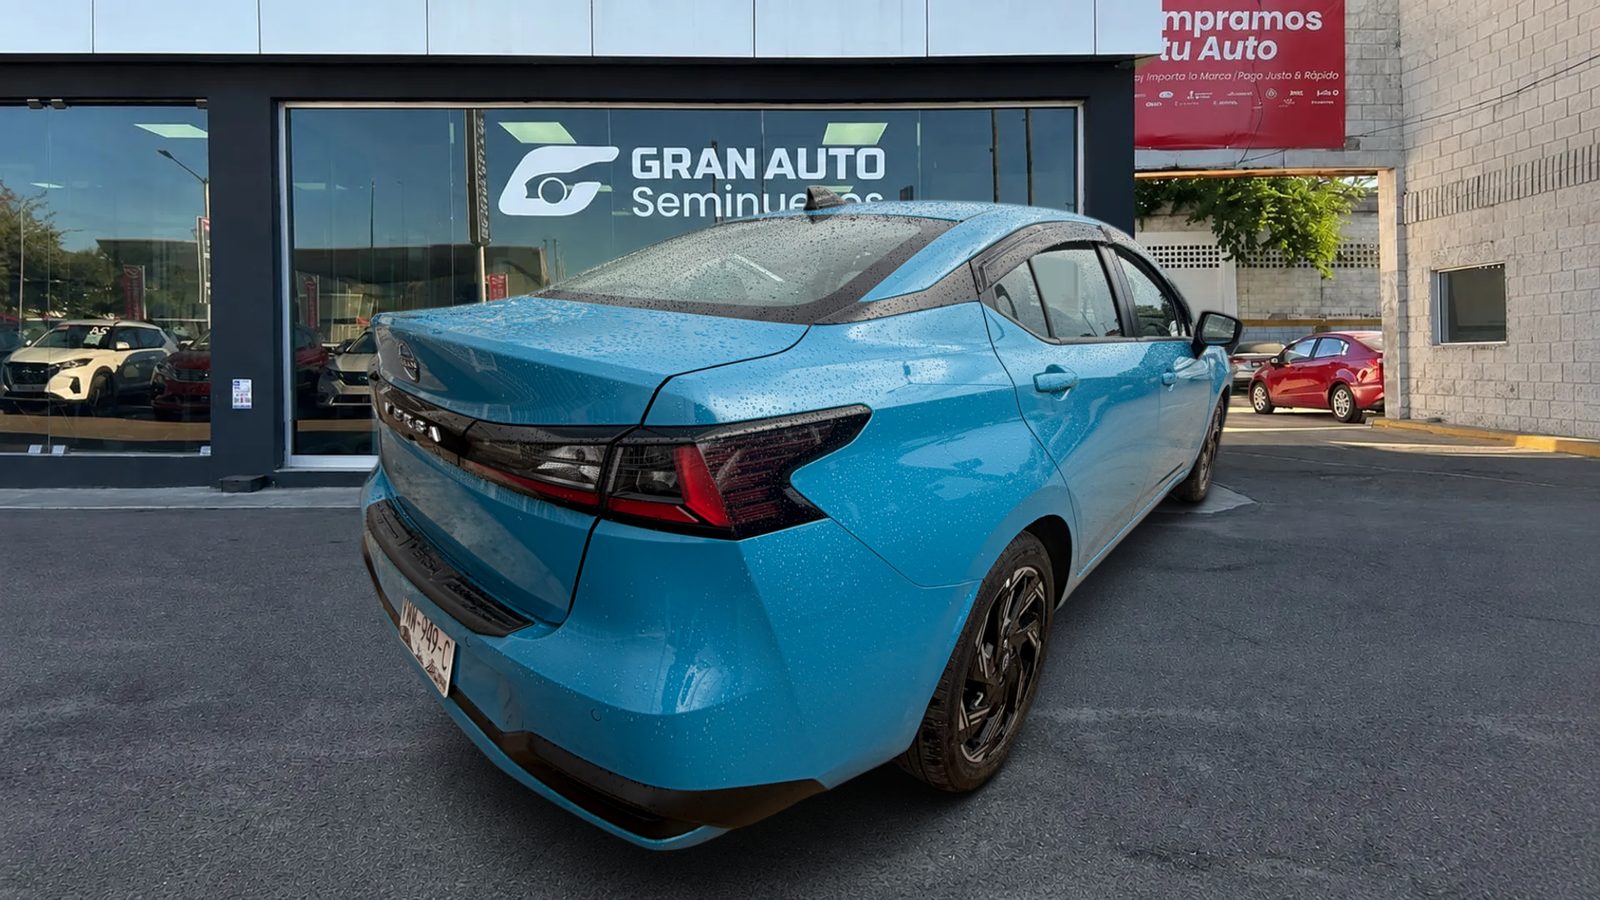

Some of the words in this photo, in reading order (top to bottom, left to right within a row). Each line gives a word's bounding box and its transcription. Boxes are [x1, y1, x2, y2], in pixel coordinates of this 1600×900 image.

[1160, 36, 1192, 61] tu
[1197, 36, 1278, 61] Auto
[1146, 72, 1186, 84] Importa
[1188, 72, 1198, 81] la
[1199, 72, 1232, 81] Marca
[1265, 71, 1292, 80] Justo
[1294, 71, 1301, 80] &
[632, 147, 756, 180] GRAN
[763, 147, 886, 180] AUTO
